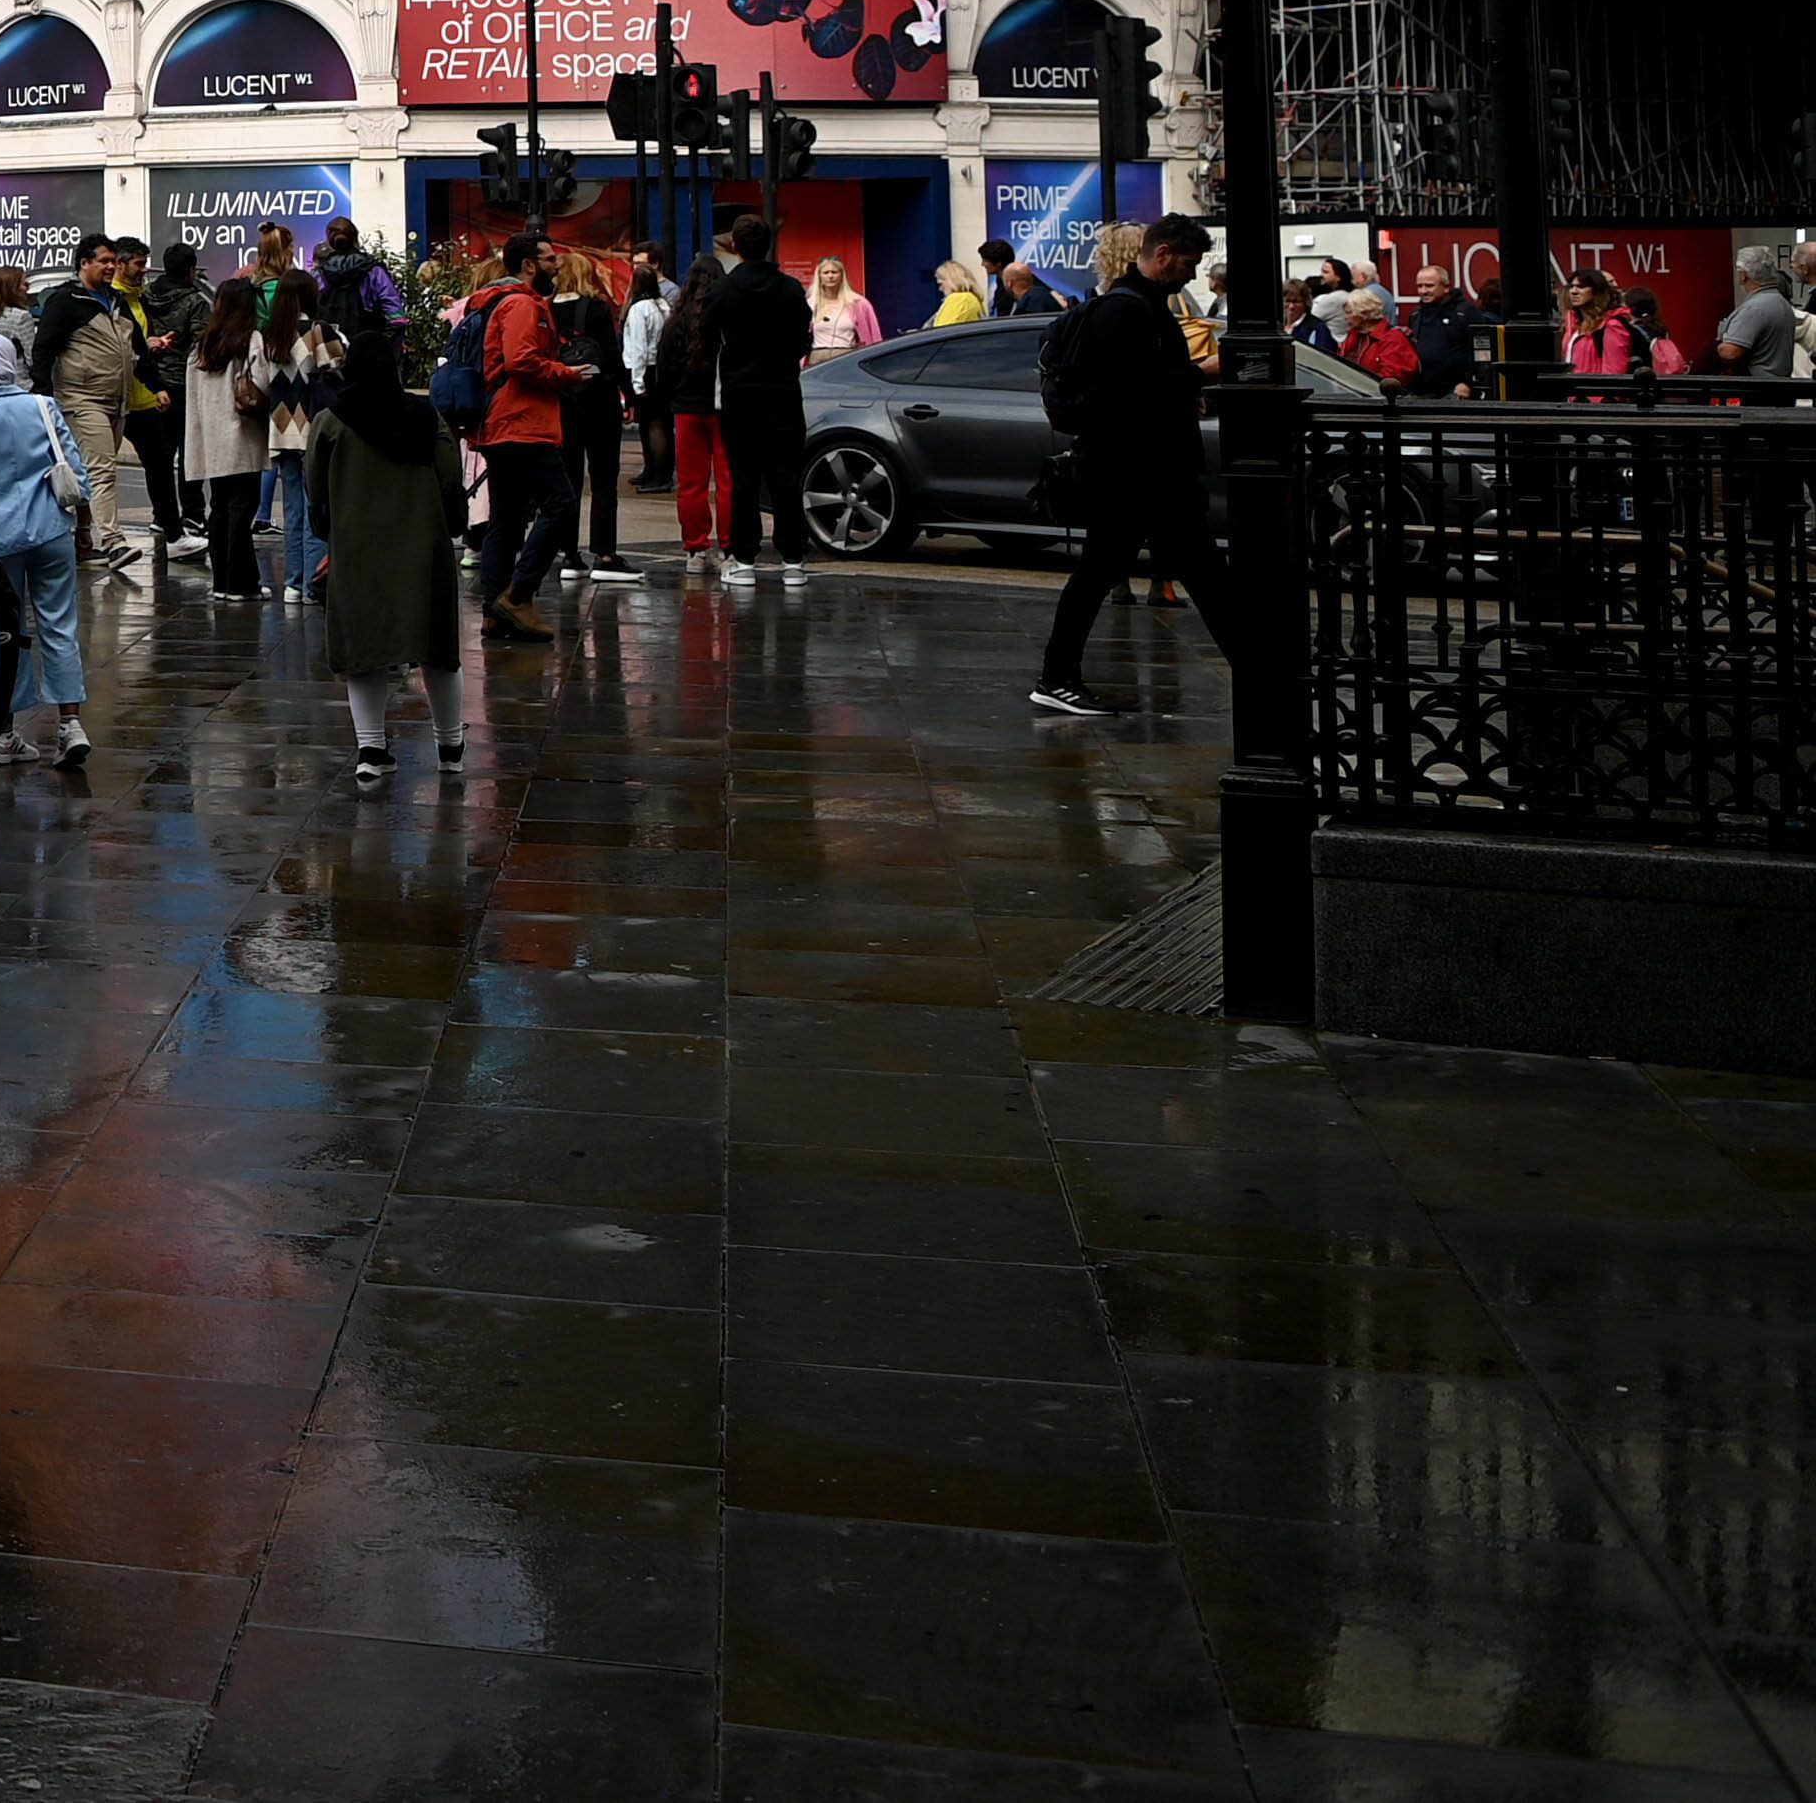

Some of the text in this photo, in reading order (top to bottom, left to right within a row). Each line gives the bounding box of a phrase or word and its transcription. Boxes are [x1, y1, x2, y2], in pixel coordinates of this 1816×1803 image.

[440, 9, 692, 45] of OFFICE and
[421, 47, 658, 85] RETAIL space
[1012, 66, 1090, 88] LUCENT
[8, 84, 86, 107] LUCENT W1
[203, 73, 314, 97] LUCENT W1
[166, 189, 336, 218] ILLUMINATED
[996, 185, 1070, 211] PRIME
[26, 226, 81, 251] space
[182, 221, 245, 249] by an
[1010, 213, 1104, 246] retail spa
[238, 247, 304, 271] ICN
[1390, 242, 1671, 304] LUCNT W1
